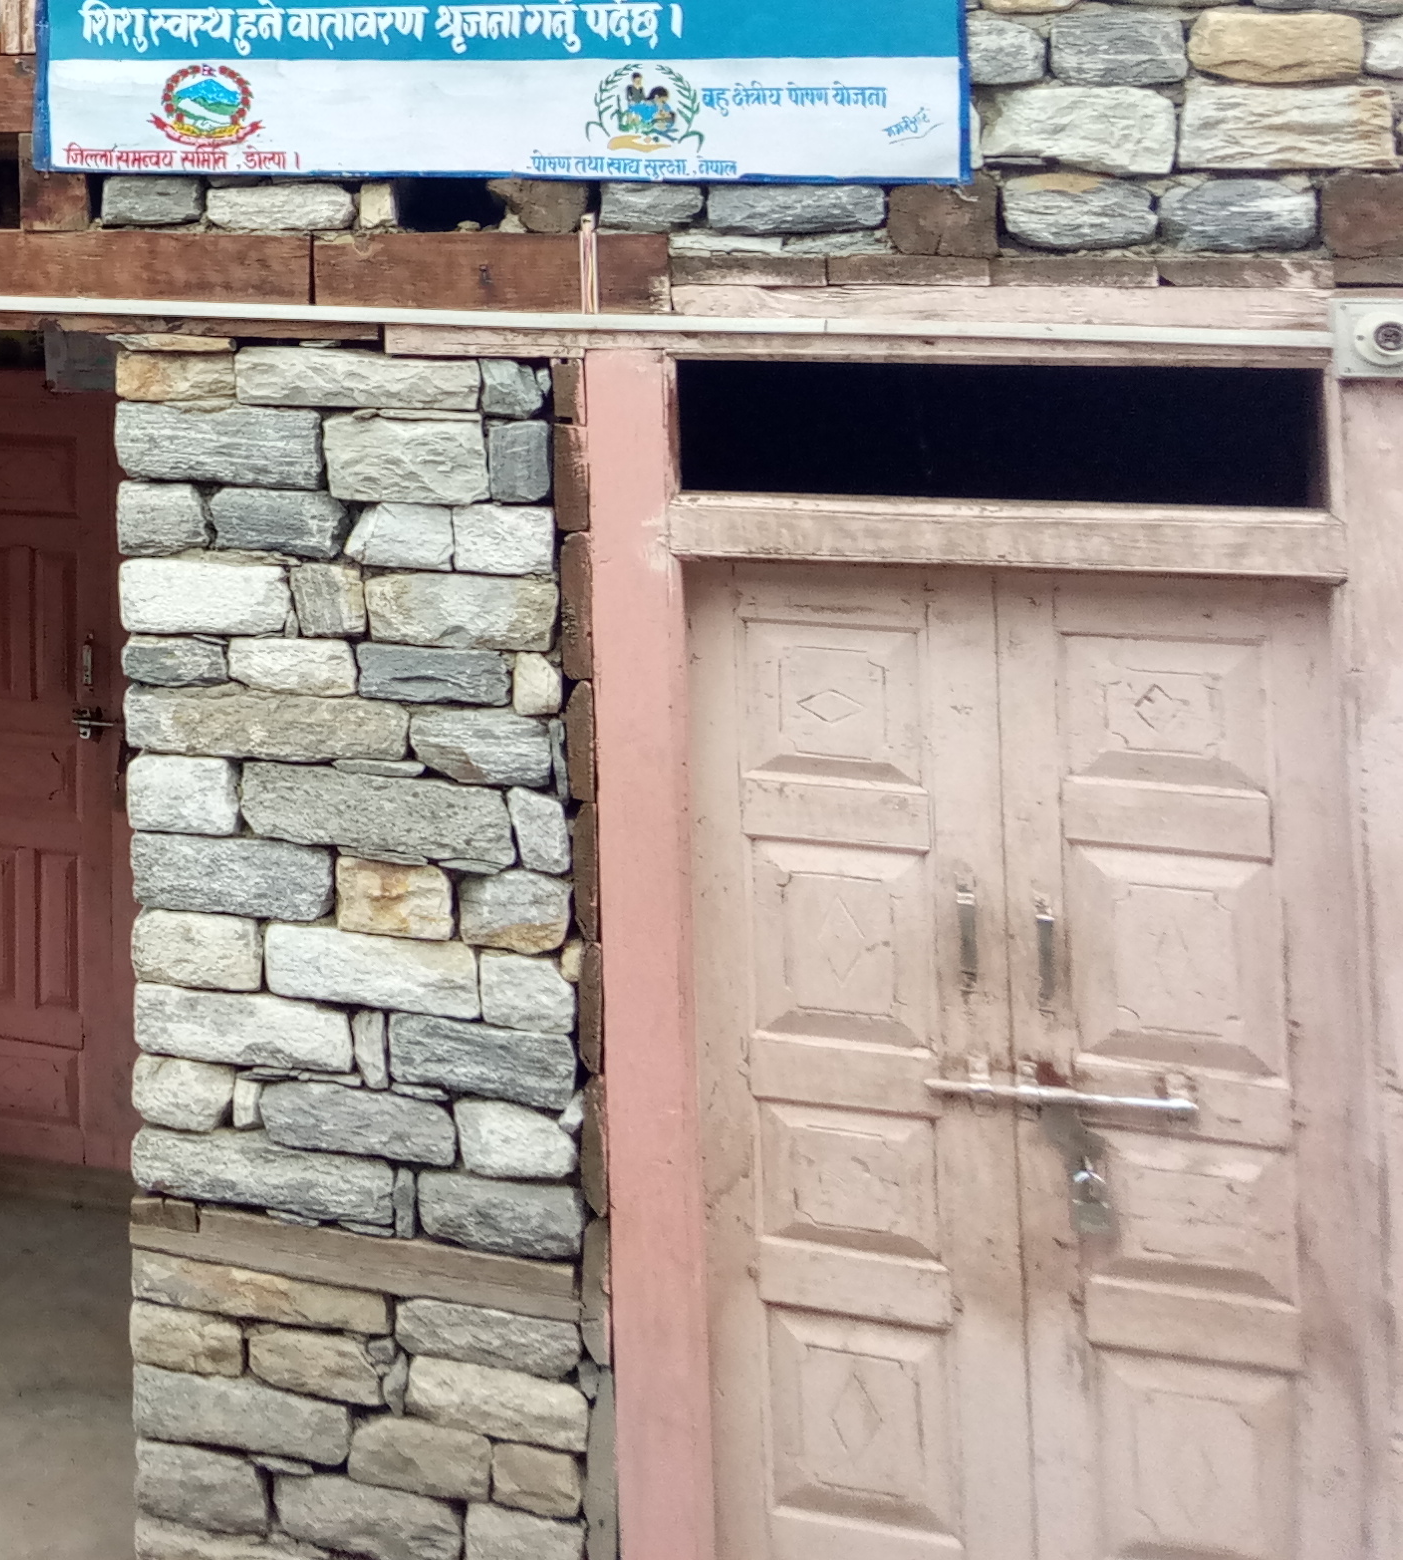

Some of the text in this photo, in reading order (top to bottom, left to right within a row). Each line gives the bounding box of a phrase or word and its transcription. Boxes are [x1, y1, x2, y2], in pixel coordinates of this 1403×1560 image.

[149, 7, 234, 47] स्वस्थ
[286, 5, 430, 50] वातावरण
[701, 87, 731, 117] बहु
[785, 81, 830, 107] पोषण
[831, 80, 887, 108] योजना
